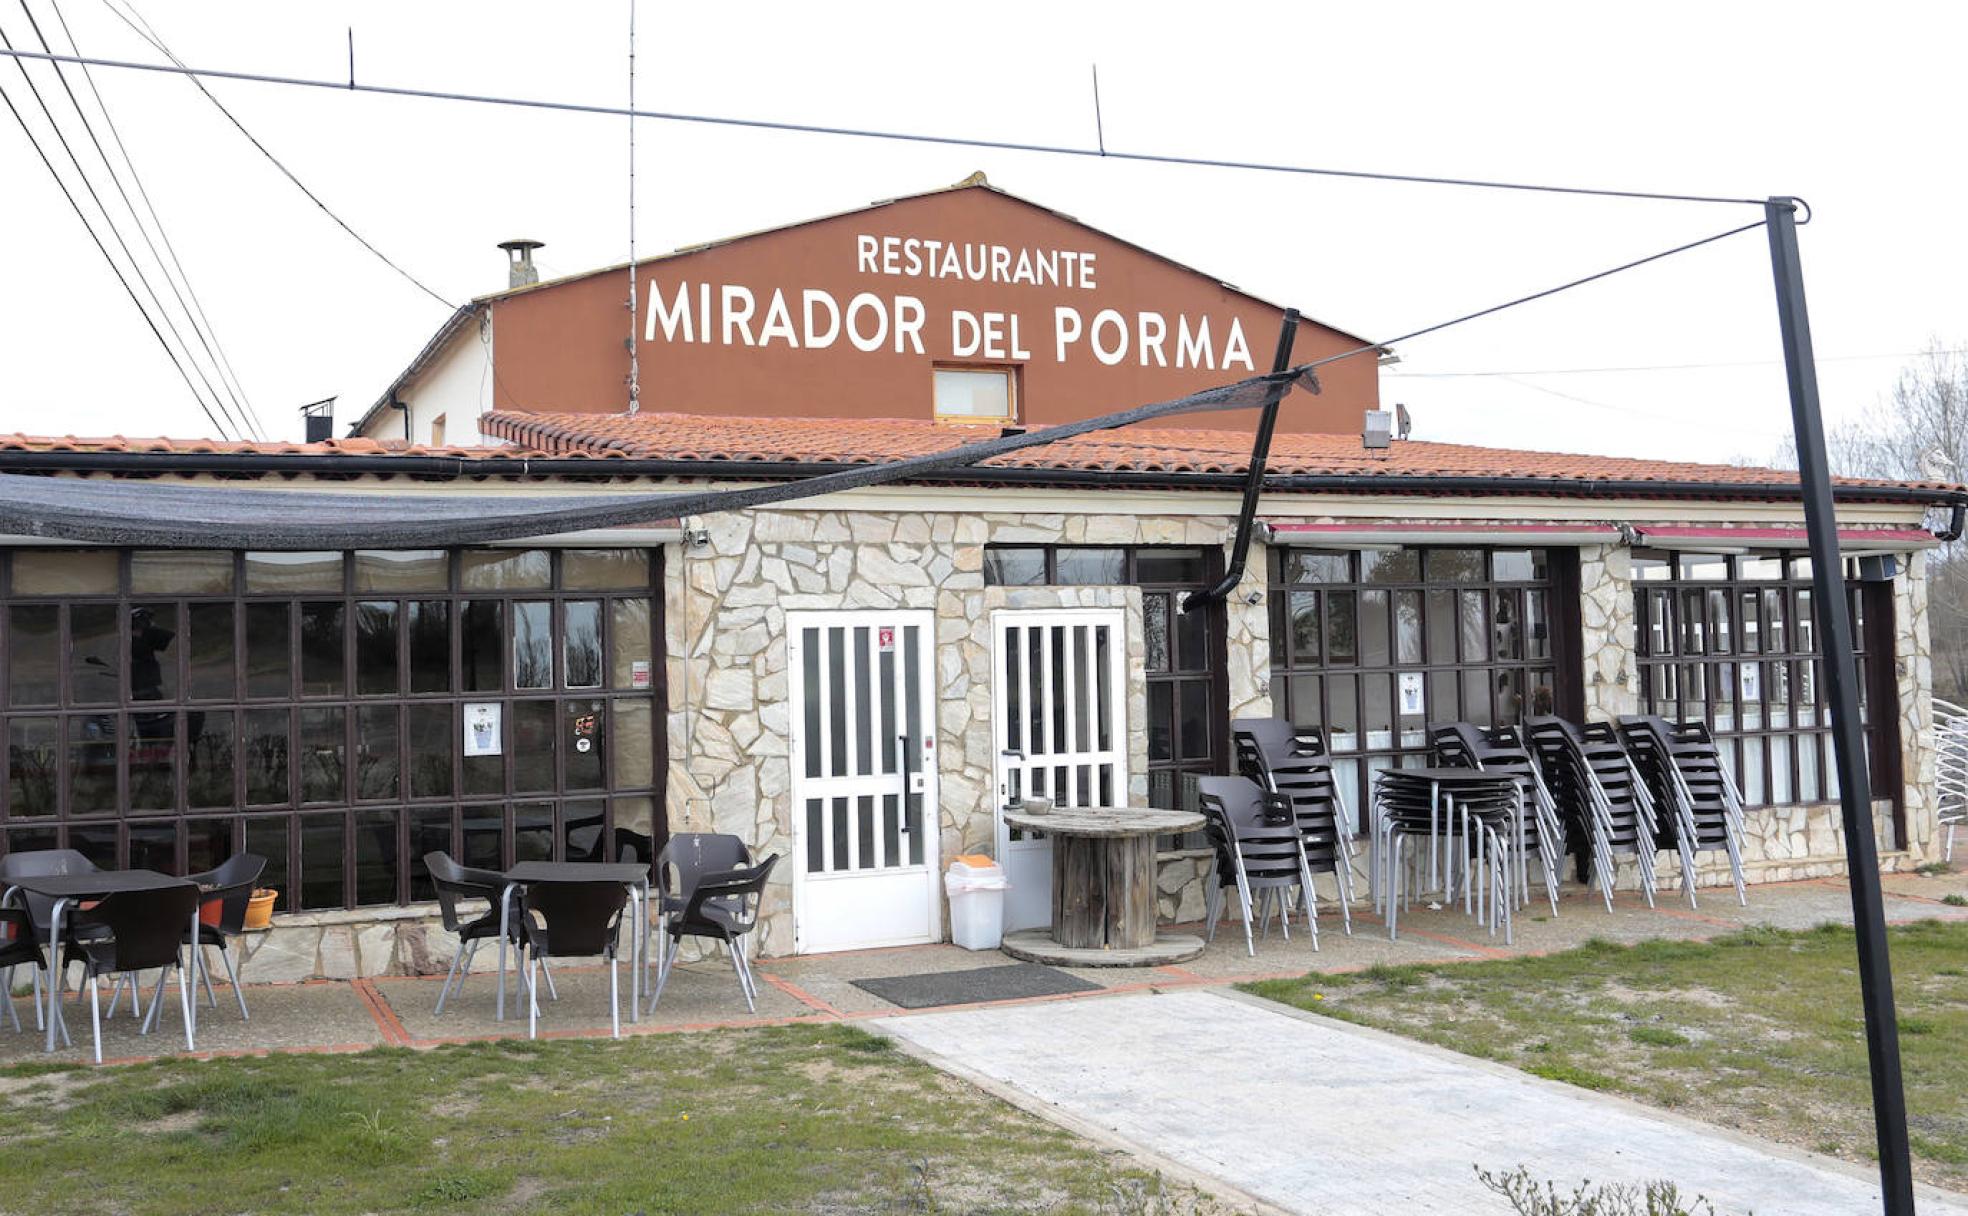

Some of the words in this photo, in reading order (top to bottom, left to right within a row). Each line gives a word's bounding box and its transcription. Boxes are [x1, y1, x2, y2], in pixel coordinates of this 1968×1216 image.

[857, 234, 1097, 289] RESTAURANTE
[644, 279, 926, 355] MIRADOR
[951, 309, 1031, 361] DEL
[1054, 306, 1255, 372] PORMA
